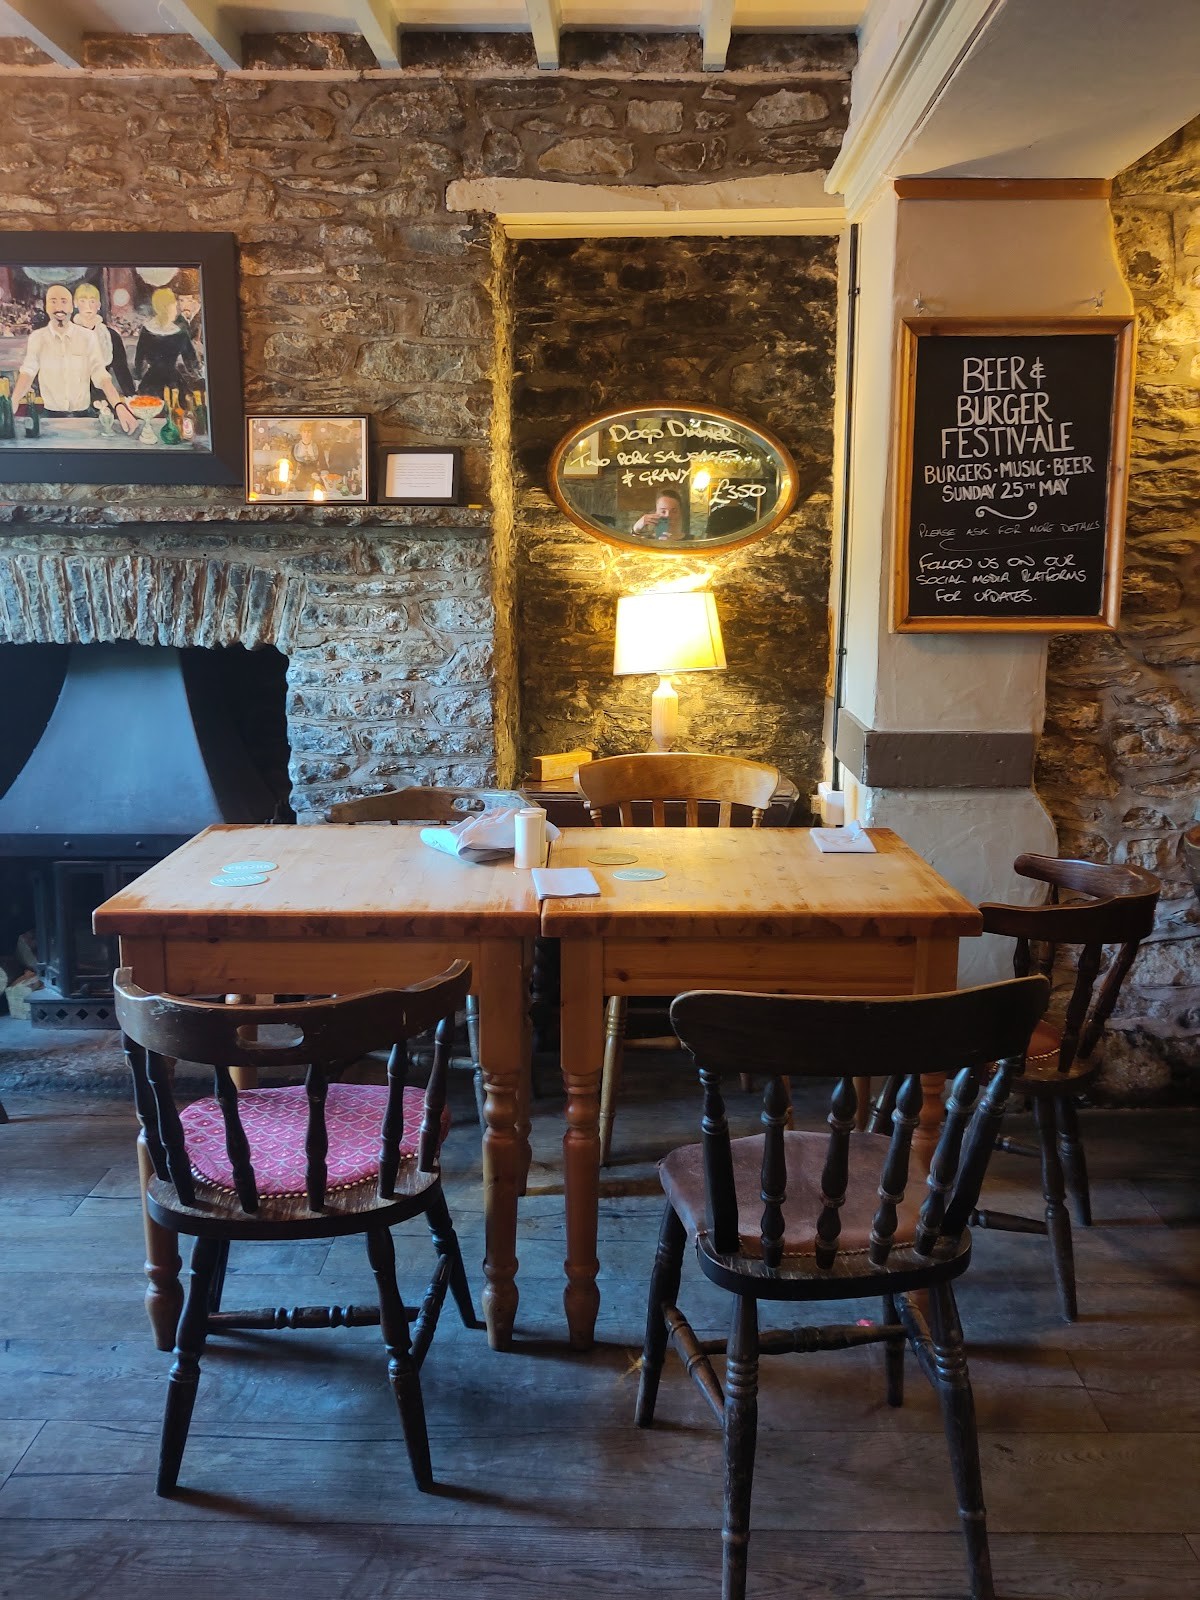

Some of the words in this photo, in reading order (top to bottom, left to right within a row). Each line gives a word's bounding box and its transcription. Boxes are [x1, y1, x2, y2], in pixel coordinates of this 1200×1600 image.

[963, 355, 1029, 394] BEER
[1029, 356, 1047, 390] &
[957, 391, 1054, 427] BURGER
[941, 422, 1076, 459] FESTIV-ALE
[616, 450, 651, 466] PORK
[621, 469, 635, 488] &
[638, 466, 691, 486] GRAVY
[924, 462, 992, 484] BURGERS
[1000, 459, 1046, 478] MUSIC
[1053, 456, 1095, 476] BEER
[941, 483, 997, 503] SUNDAY
[1039, 477, 1070, 497] MAY
[918, 522, 957, 538] PLEASE
[966, 526, 989, 537] ASK
[998, 523, 1022, 536] FOR
[1029, 521, 1054, 533] MORE
[1060, 519, 1101, 533] DETAILS
[919, 552, 973, 574] FOLLOW
[977, 557, 1000, 569] US
[1006, 554, 1036, 567] ON
[1043, 553, 1077, 567] OUR
[915, 574, 967, 585] SOCIAL
[972, 571, 1011, 584] MEDIA
[1021, 567, 1088, 583] PLATFORMS
[935, 588, 962, 602] FOR
